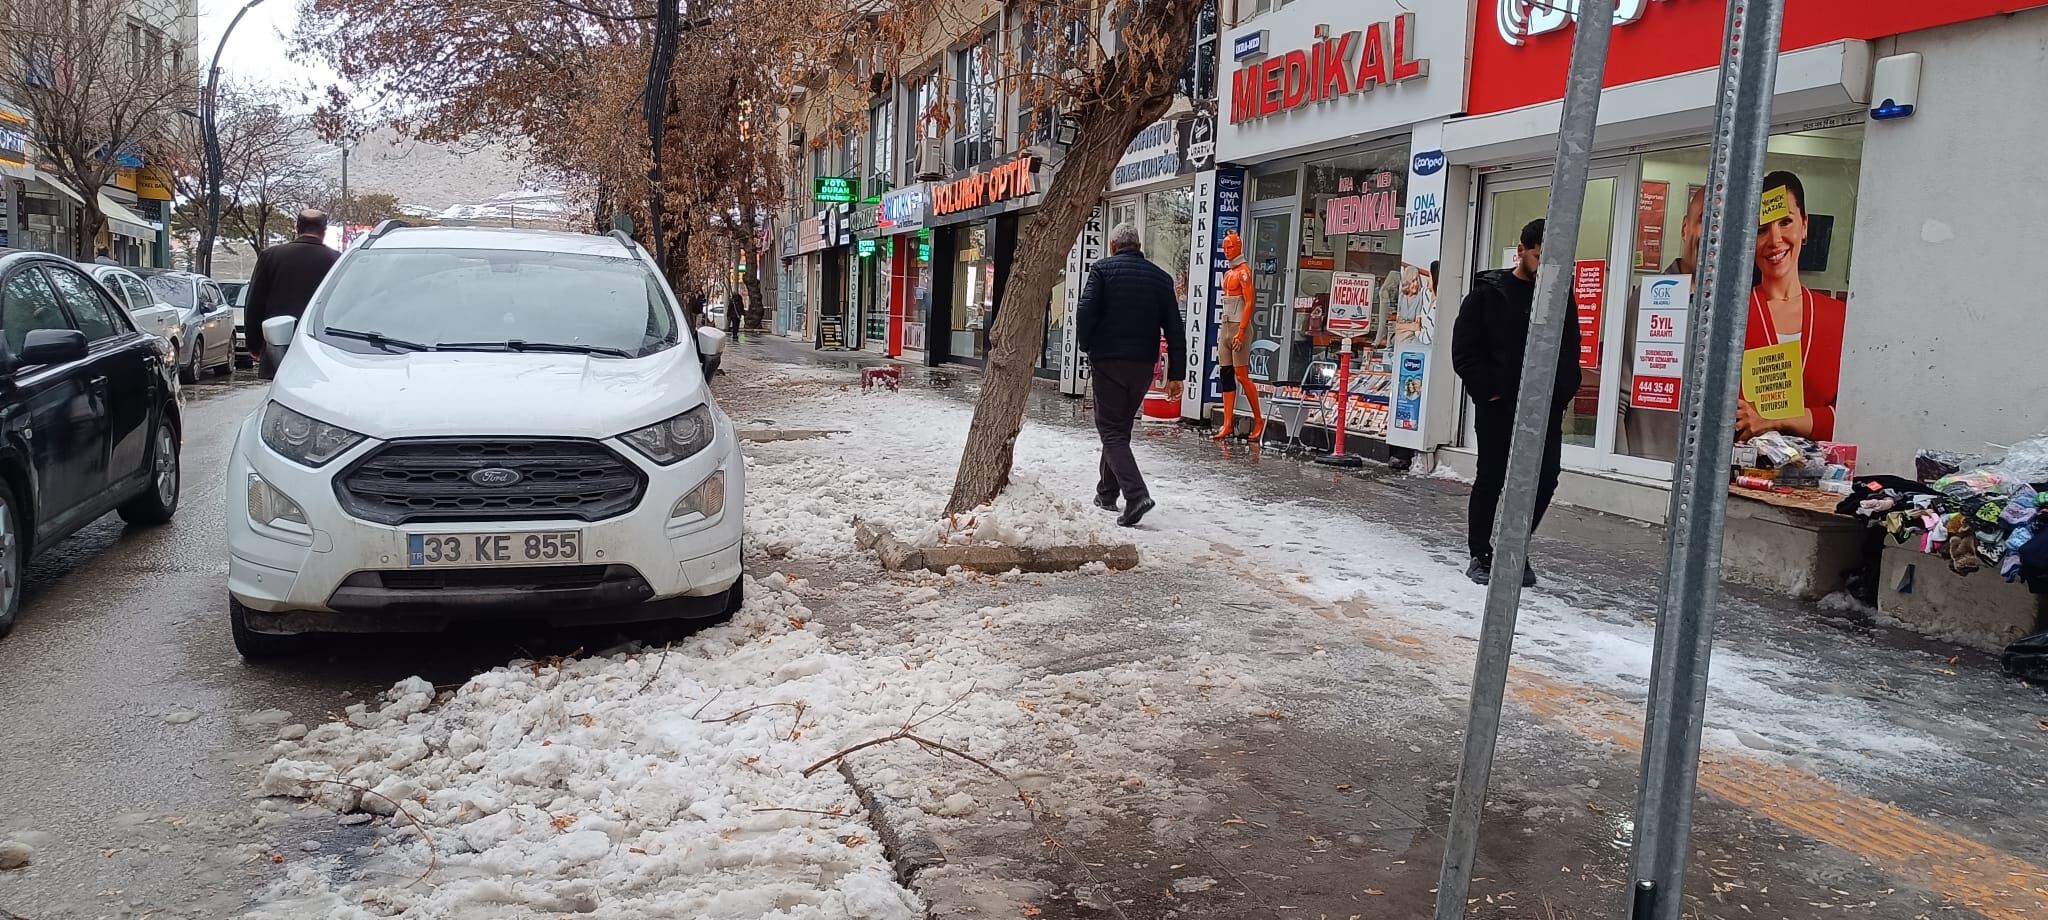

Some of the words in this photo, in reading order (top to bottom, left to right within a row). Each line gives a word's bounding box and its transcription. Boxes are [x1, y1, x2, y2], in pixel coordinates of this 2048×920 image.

[1230, 13, 1424, 126] MEDİKAL
[1115, 161, 1141, 185] ERKEK
[825, 178, 846, 186] FOTO
[821, 186, 850, 194] DURAN
[933, 172, 985, 216] DOLUNAY
[1219, 191, 1239, 199] ONA
[1219, 204, 1239, 212] BAK
[1325, 181, 1401, 236] MEDİKAL
[1414, 192, 1436, 211] ONA
[1195, 183, 1208, 265] ERKEK
[1419, 207, 1441, 226] BAK
[1333, 286, 1369, 306] MEDİKAL
[1653, 288, 1671, 298] SGK
[1650, 314, 1658, 330] 5
[1658, 317, 1673, 330] YIL
[1187, 284, 1203, 400] KUAFÖRÜ
[1249, 354, 1270, 376] SGK
[1758, 353, 1785, 365] DUYANLAR
[1752, 361, 1792, 376] DUYMAYANLARA
[1759, 371, 1787, 384] DUYURSUN
[1639, 381, 1653, 392] 444
[1653, 382, 1664, 393] 35
[1664, 383, 1674, 394] 48
[1755, 380, 1792, 394] DUYMAYANLAR
[1760, 400, 1789, 412] BUYURSUN
[481, 470, 508, 483] Ford
[425, 537, 461, 562] 33
[475, 535, 511, 561] KE
[524, 533, 576, 559] 855
[411, 553, 423, 561] TR
